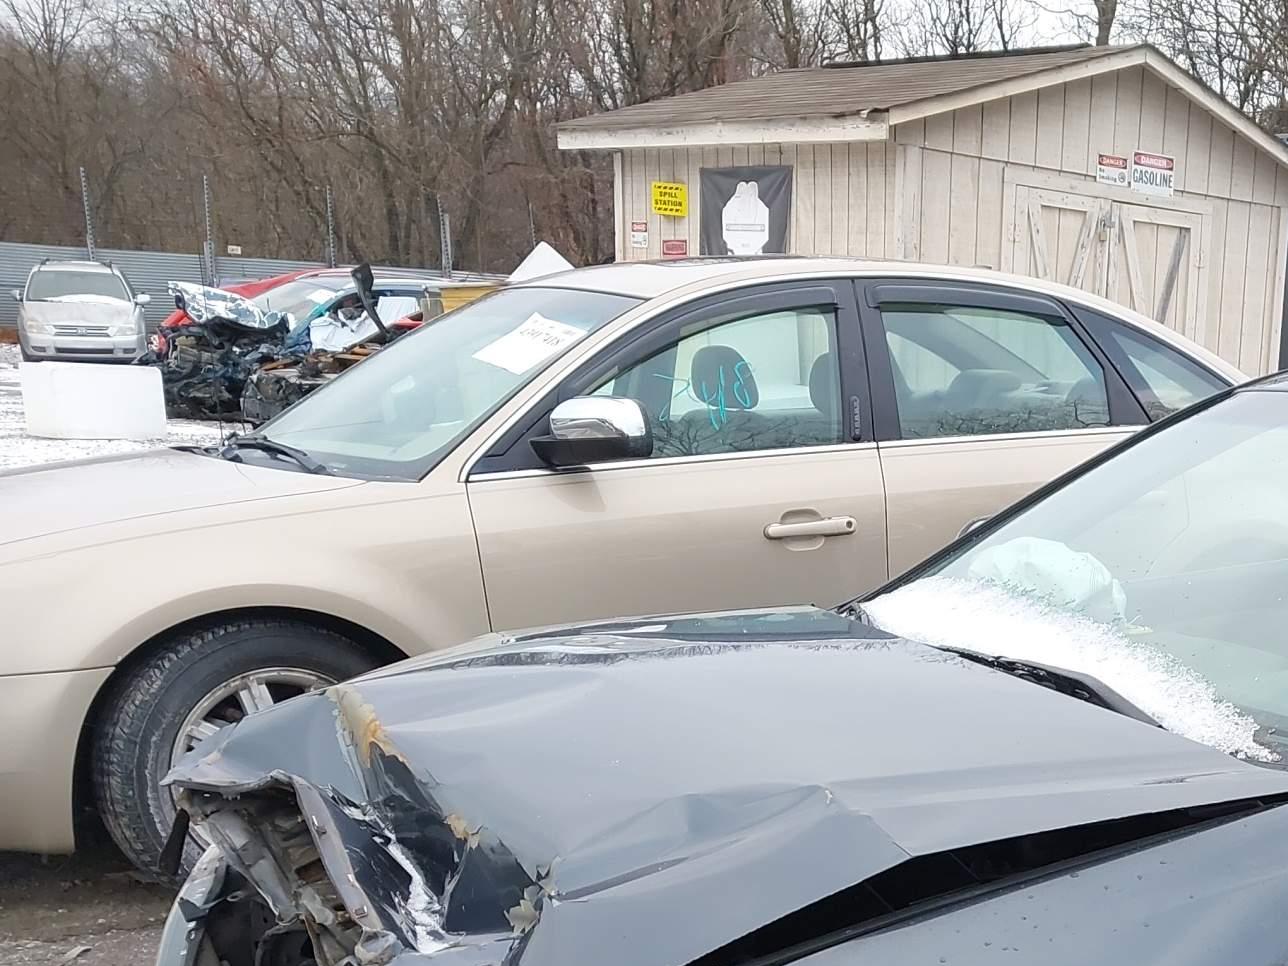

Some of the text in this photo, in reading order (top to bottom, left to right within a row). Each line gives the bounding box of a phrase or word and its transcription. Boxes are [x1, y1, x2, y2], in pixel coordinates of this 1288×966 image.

[1140, 155, 1167, 168] DANGER
[1133, 168, 1173, 188] GASOLINE
[659, 191, 678, 199] SPILL
[654, 199, 683, 207] STATION
